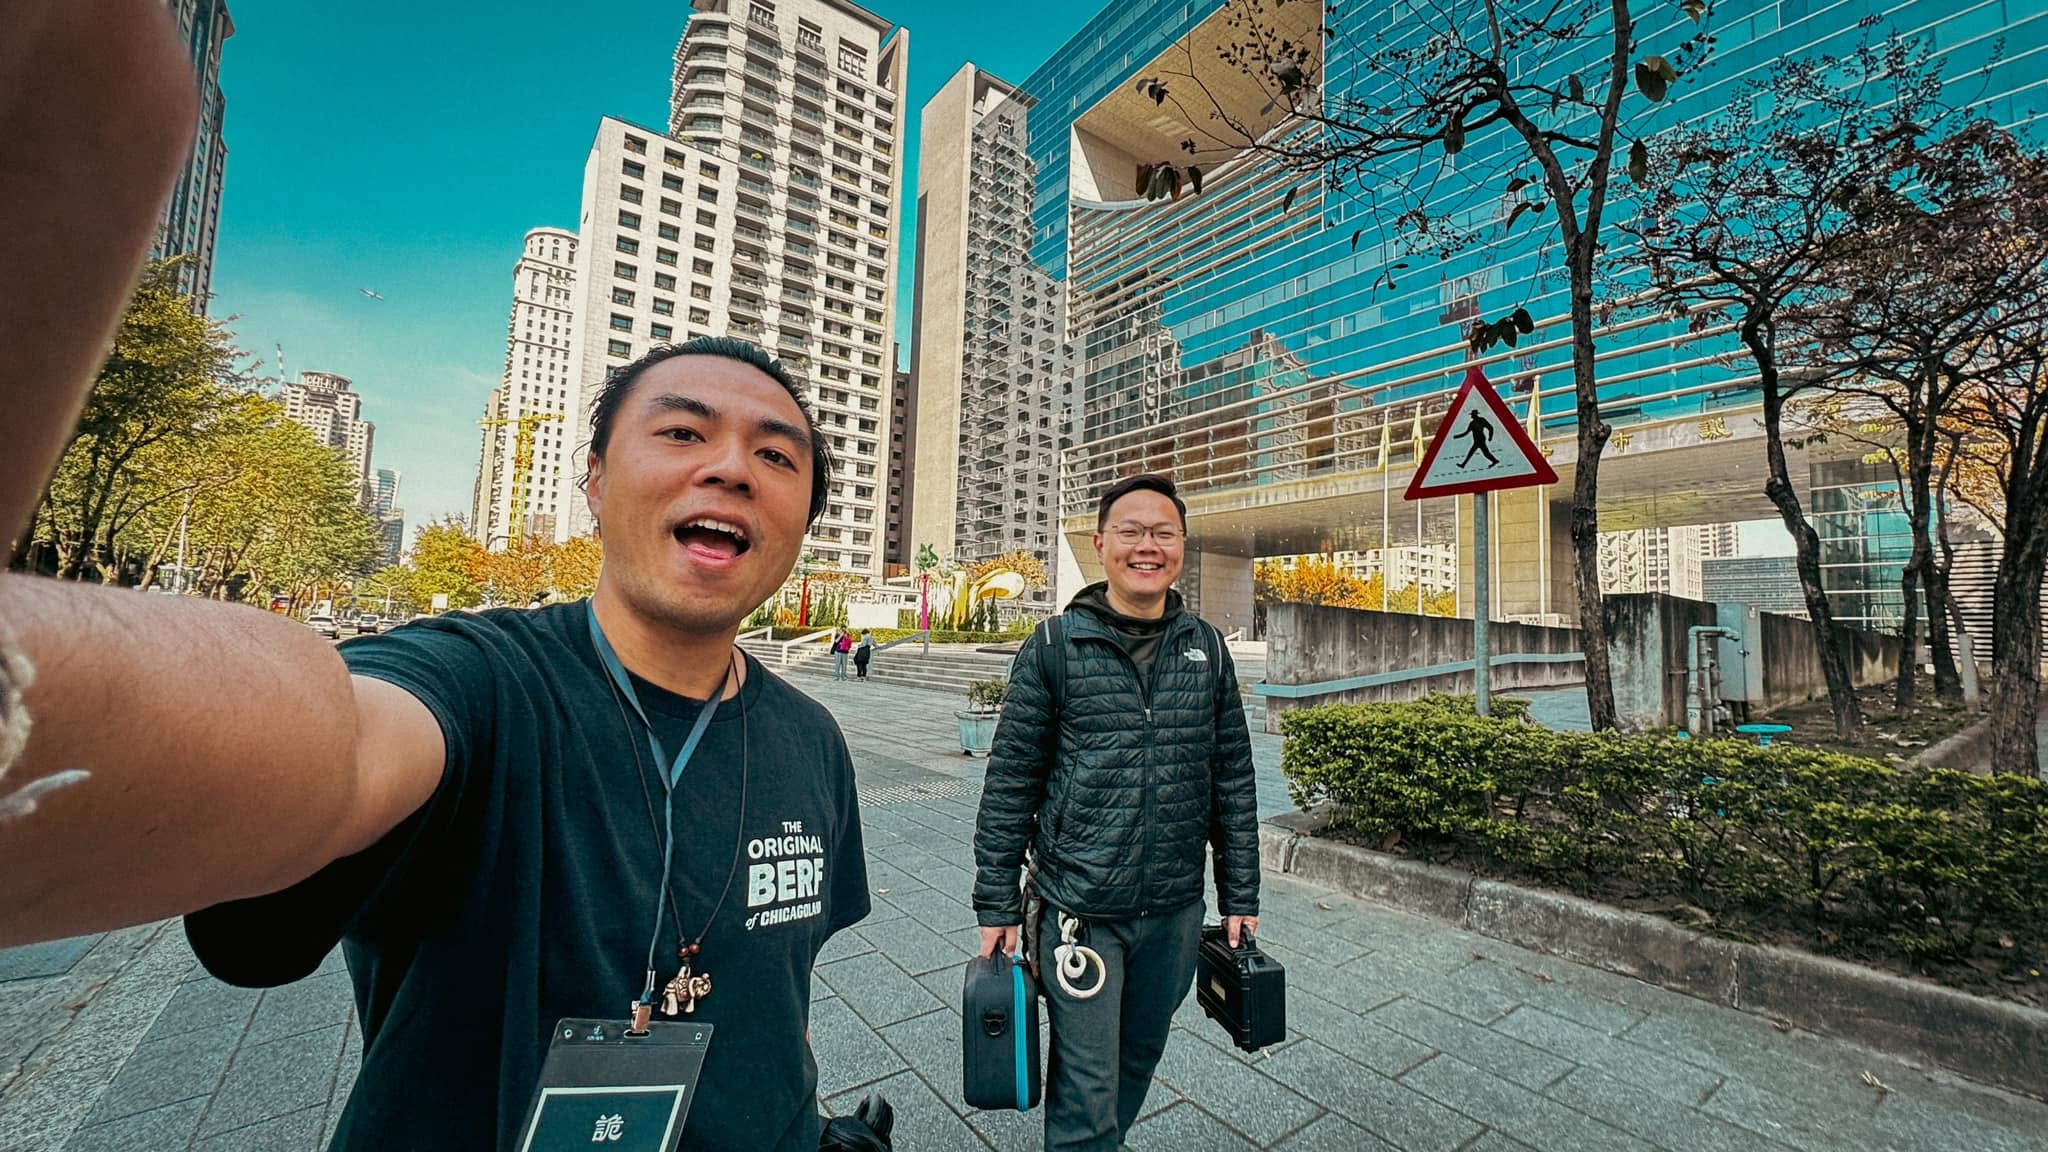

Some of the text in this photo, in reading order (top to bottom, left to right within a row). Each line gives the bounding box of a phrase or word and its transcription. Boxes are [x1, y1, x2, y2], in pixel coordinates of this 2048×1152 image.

[781, 820, 803, 833] THE
[747, 835, 824, 860] ORIGINAL
[747, 857, 824, 908] BERF
[745, 912, 760, 931] of
[592, 1113, 625, 1142] 詭
